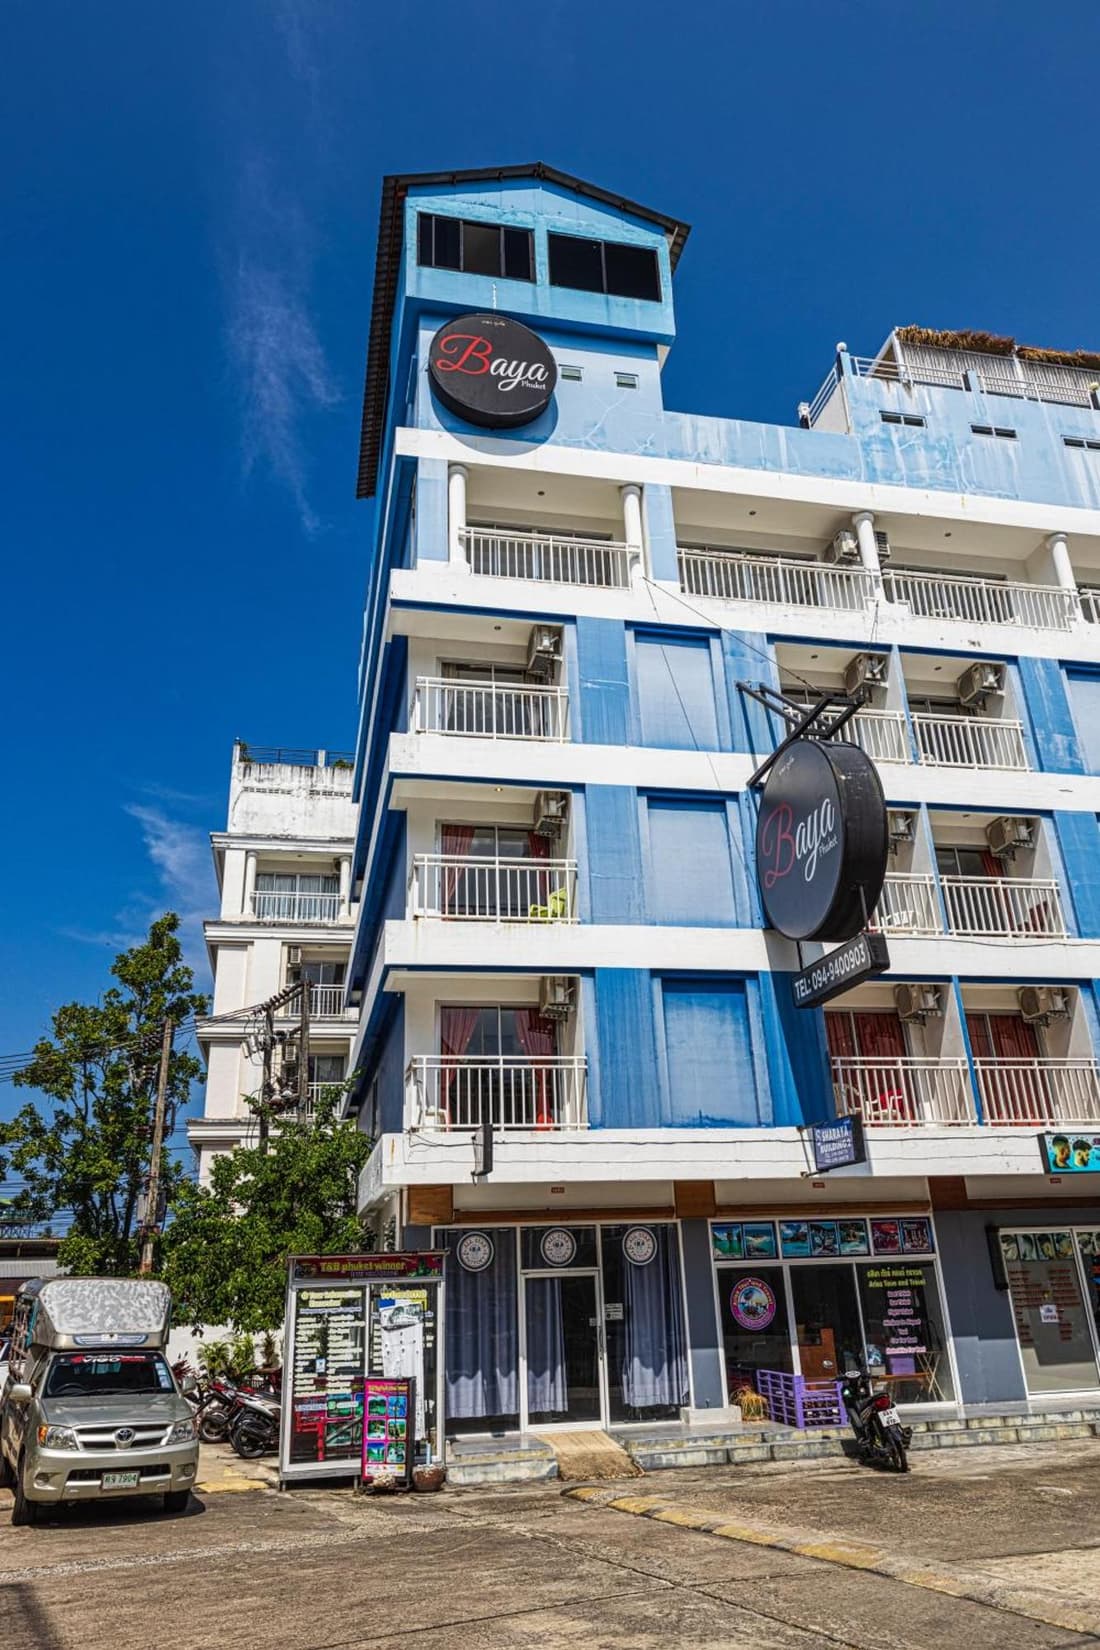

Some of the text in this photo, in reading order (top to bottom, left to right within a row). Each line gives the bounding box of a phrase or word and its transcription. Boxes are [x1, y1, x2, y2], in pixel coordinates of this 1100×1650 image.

[435, 333, 549, 392] Baya
[521, 380, 546, 391] Phuket
[762, 798, 835, 888] Baya
[795, 943, 867, 1000] TEL: 094-9400903
